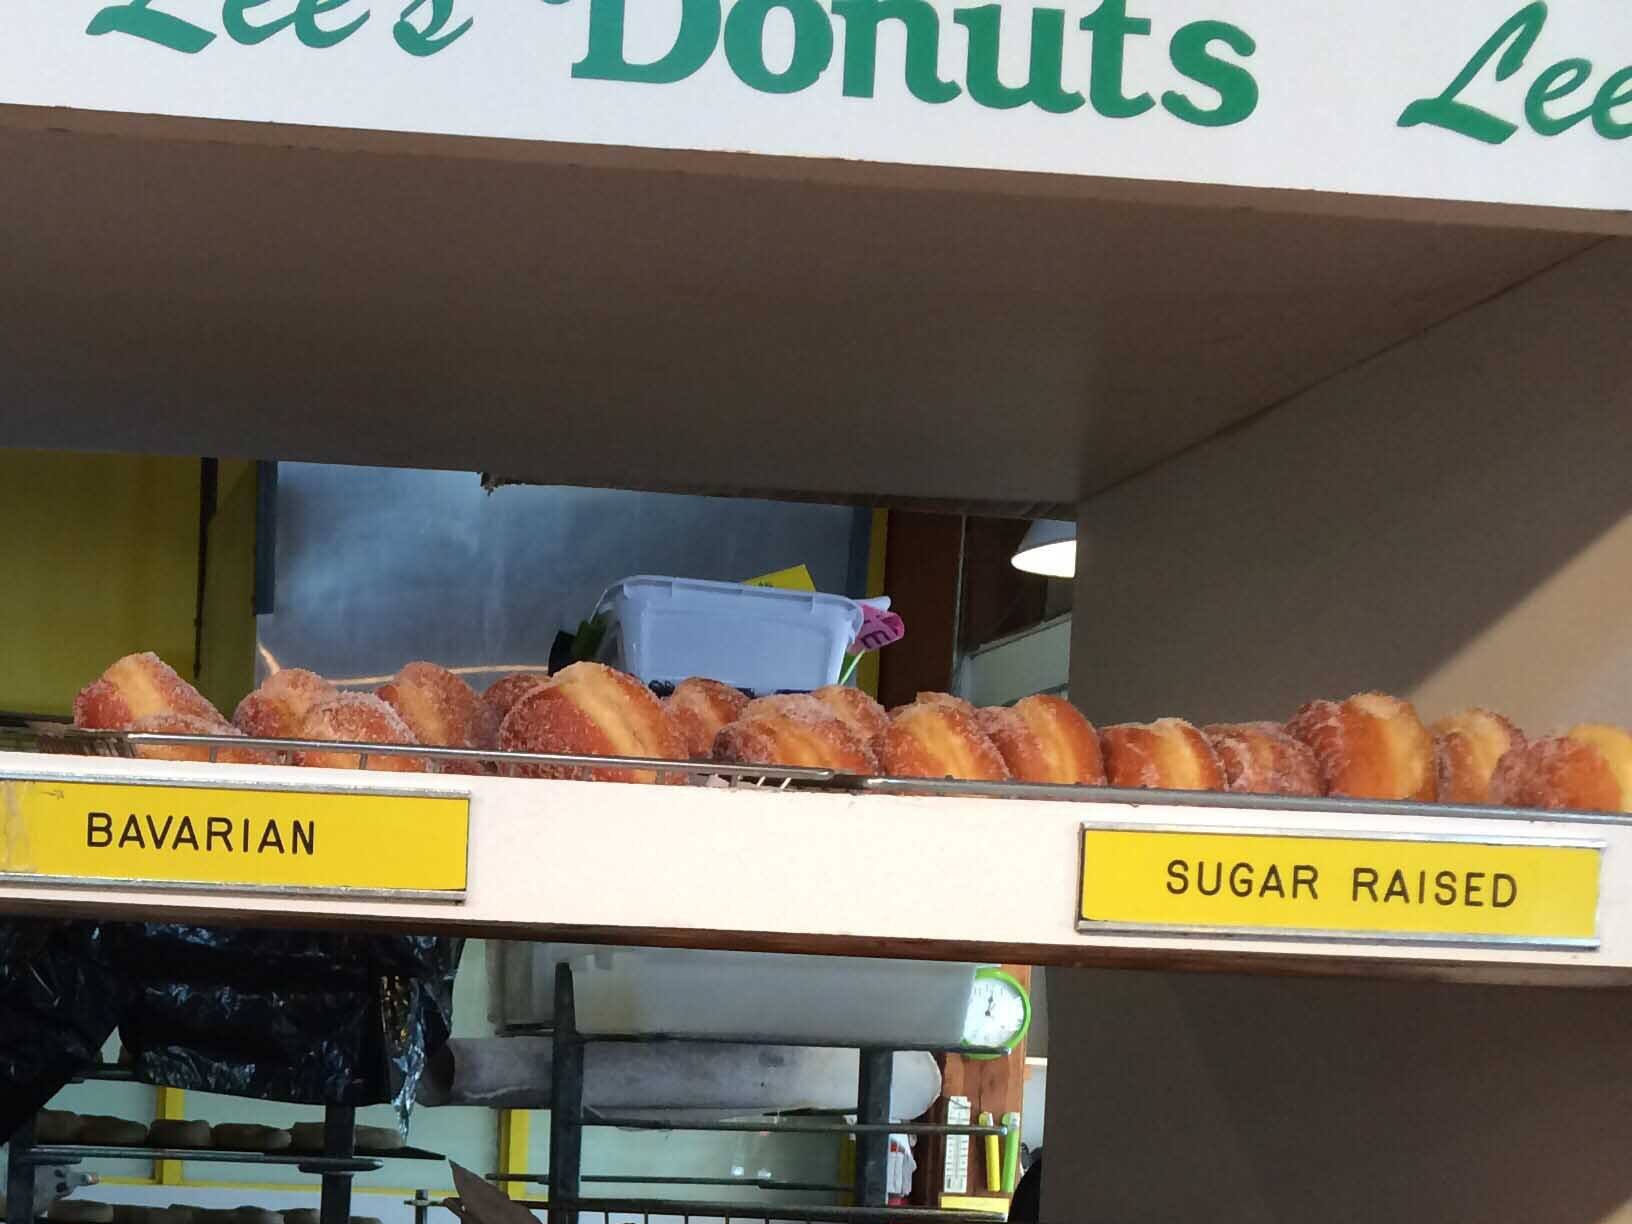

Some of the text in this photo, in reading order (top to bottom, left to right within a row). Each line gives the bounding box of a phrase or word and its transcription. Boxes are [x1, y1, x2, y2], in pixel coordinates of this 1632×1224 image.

[85, 0, 1260, 127] ees Donuts
[85, 810, 316, 856] BAVARIAN
[1165, 858, 1518, 909] SUGAR RAISED
